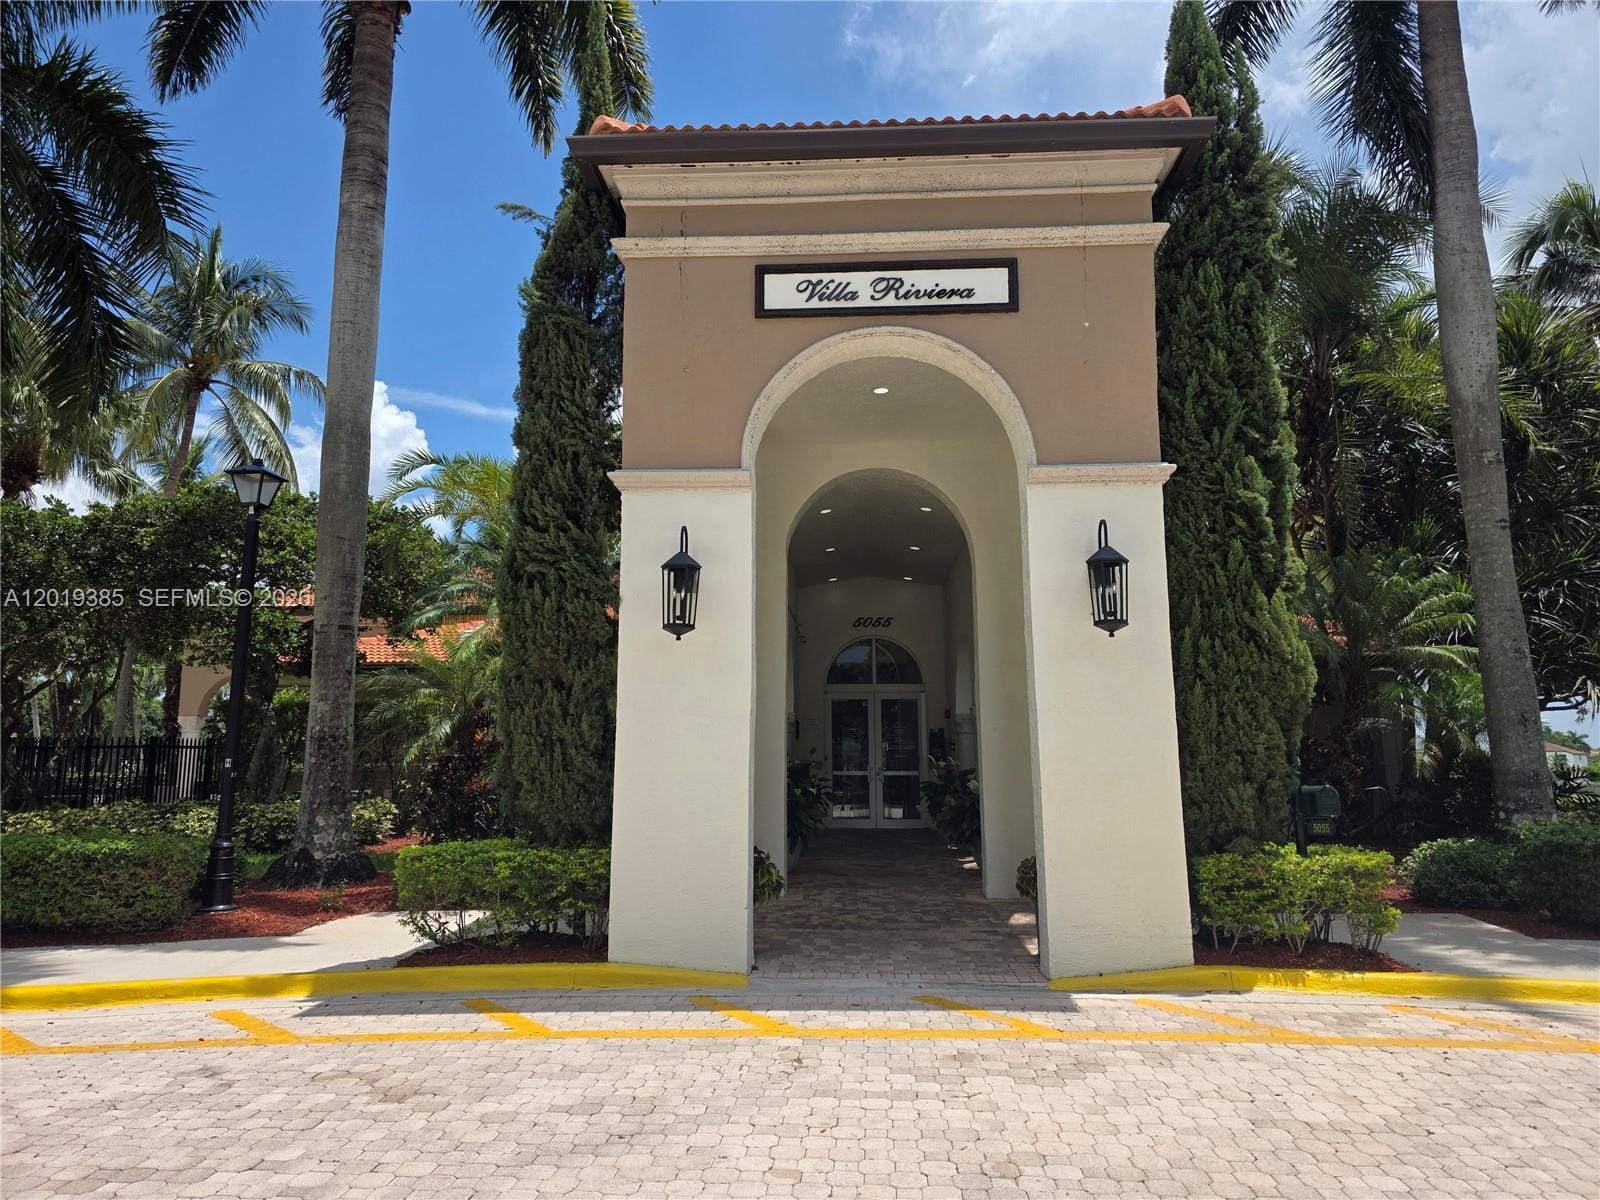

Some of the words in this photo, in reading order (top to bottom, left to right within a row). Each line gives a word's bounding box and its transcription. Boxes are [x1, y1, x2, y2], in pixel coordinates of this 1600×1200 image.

[796, 278, 860, 302] Villa
[870, 277, 975, 300] Riviera
[852, 616, 894, 628] 5055
[1312, 823, 1330, 833] 5055
